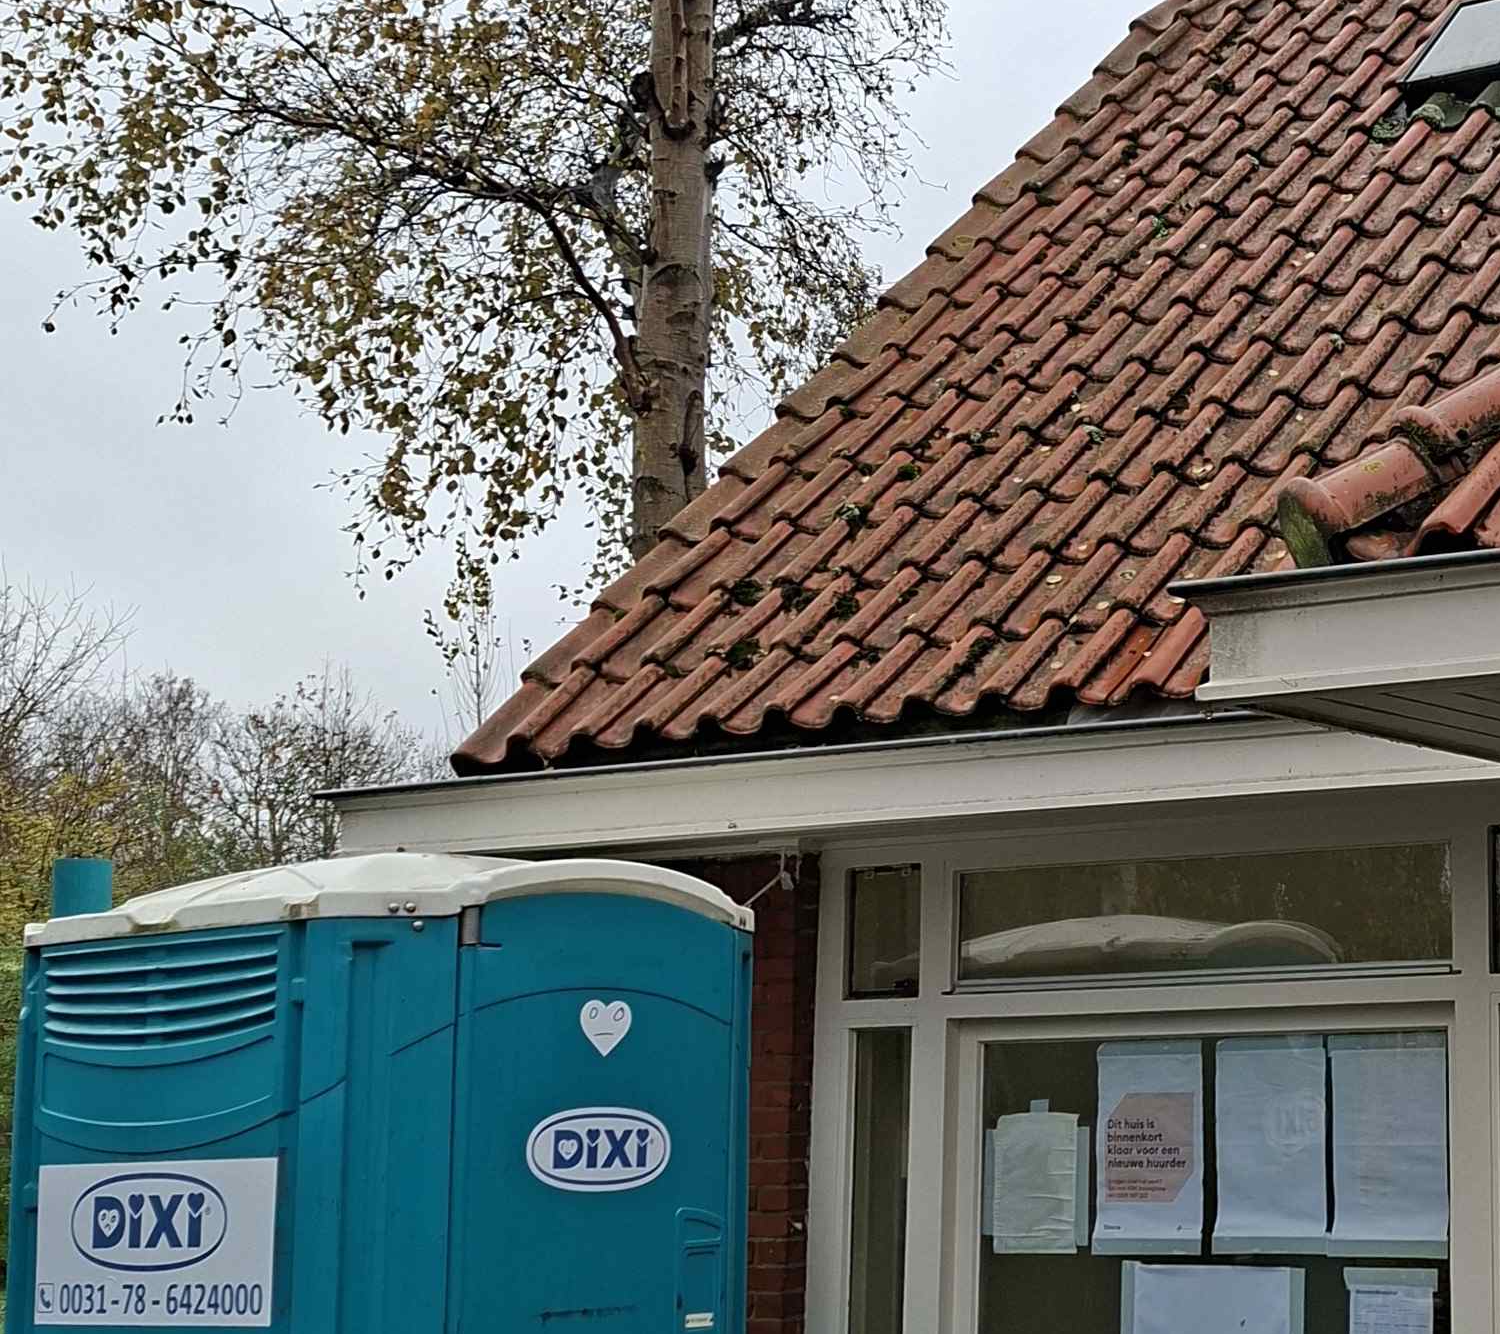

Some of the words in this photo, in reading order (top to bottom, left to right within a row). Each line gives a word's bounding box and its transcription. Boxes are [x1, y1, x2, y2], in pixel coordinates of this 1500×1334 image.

[1107, 1118, 1122, 1129] Dit
[1124, 1118, 1144, 1129] huis
[1147, 1118, 1155, 1129] is
[1107, 1131, 1163, 1143] binnenkort
[1107, 1144, 1133, 1155] klaar
[1136, 1147, 1159, 1155] voor
[1161, 1147, 1180, 1155] een
[1107, 1157, 1144, 1169] nieuwe
[1146, 1157, 1186, 1169] huurder
